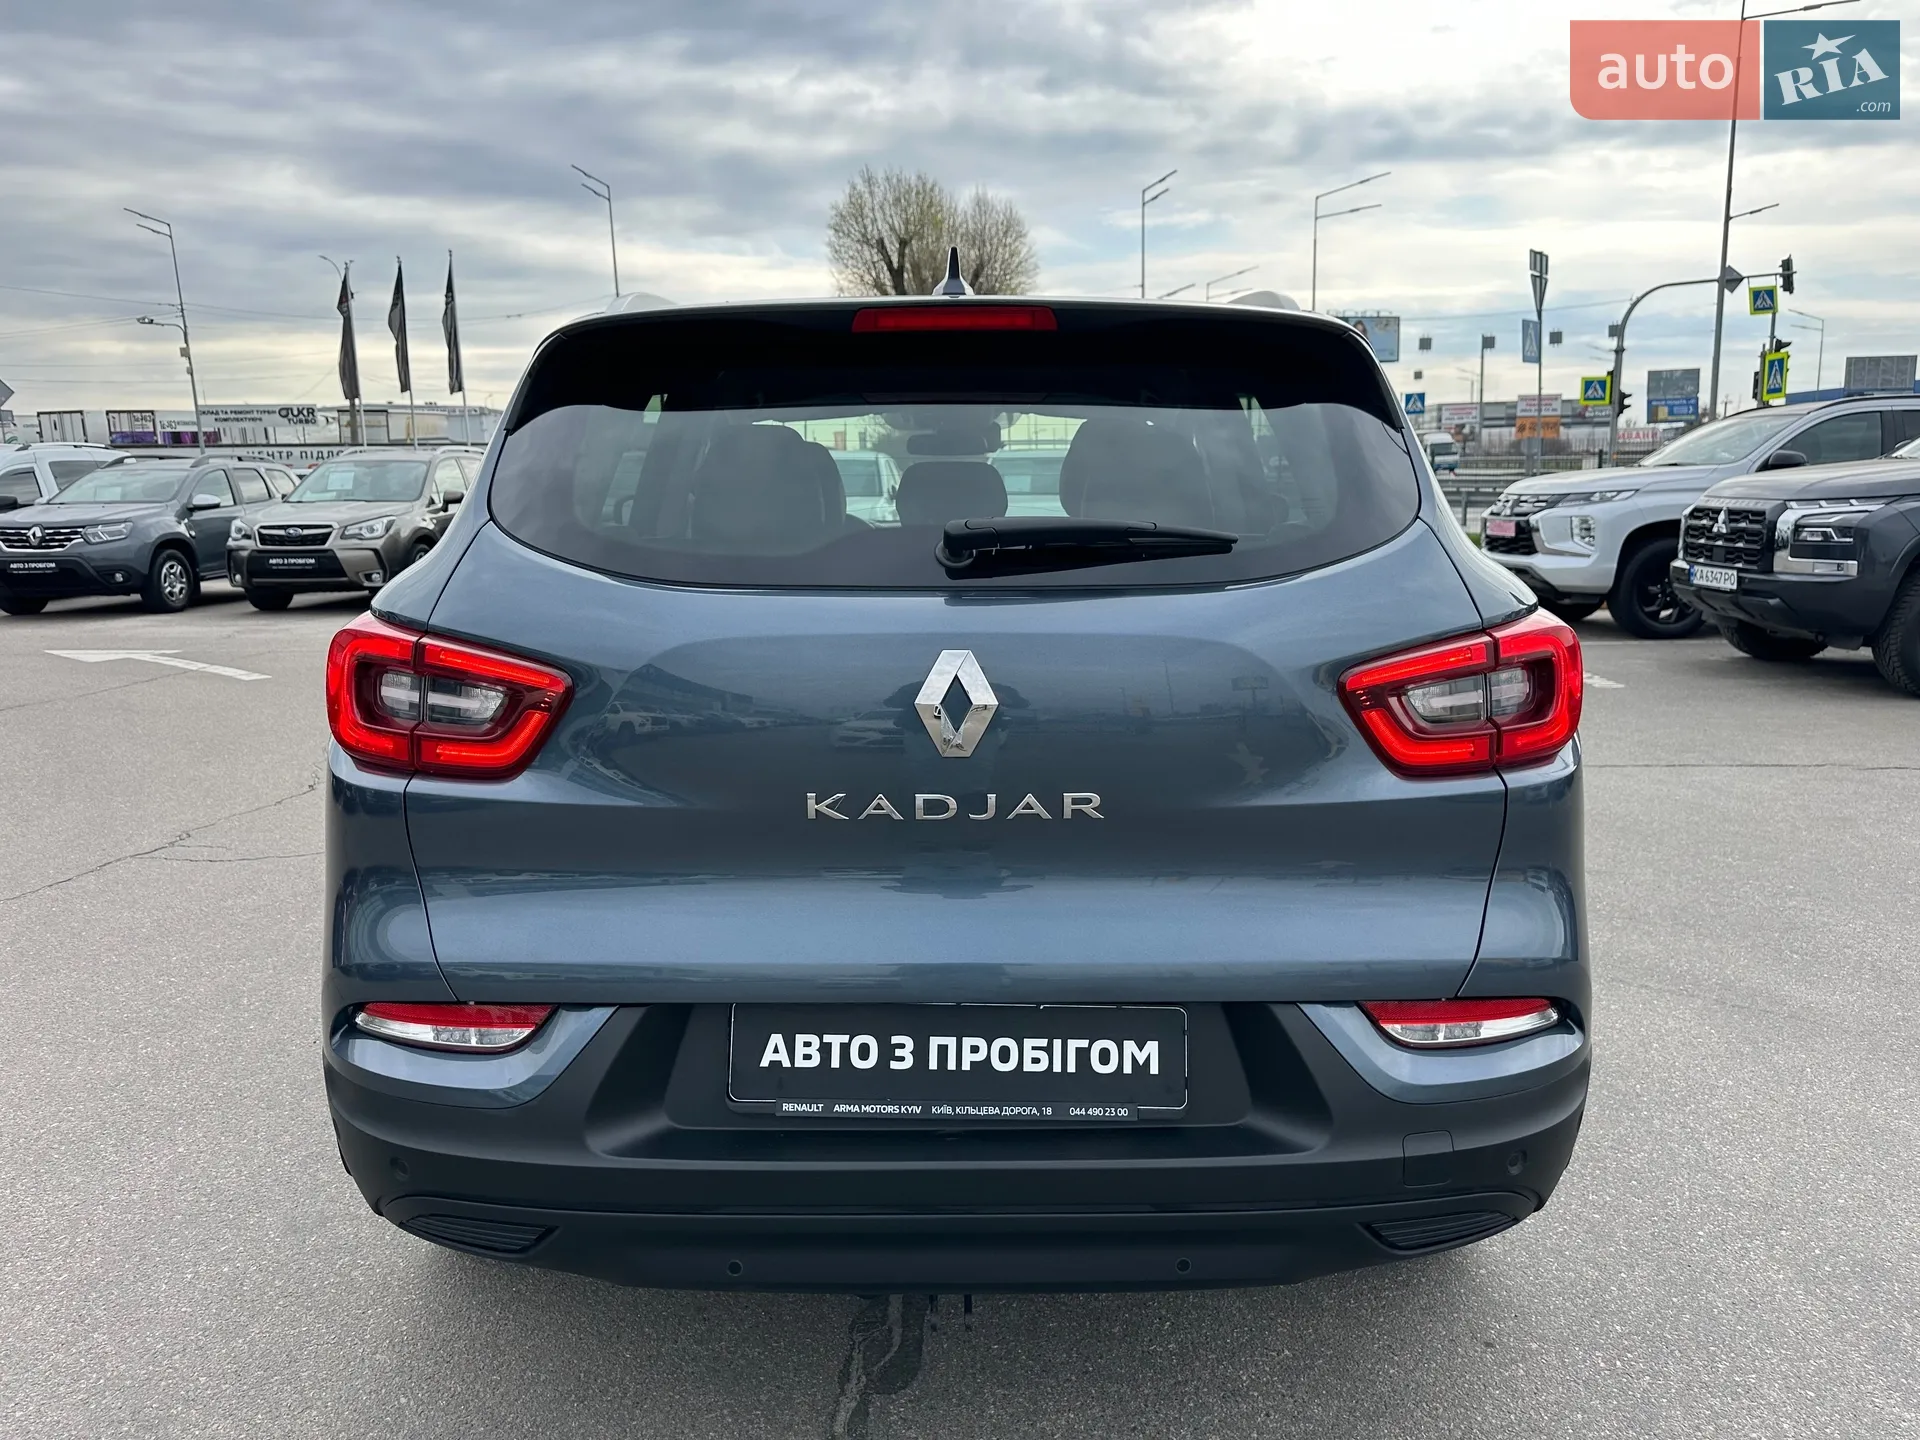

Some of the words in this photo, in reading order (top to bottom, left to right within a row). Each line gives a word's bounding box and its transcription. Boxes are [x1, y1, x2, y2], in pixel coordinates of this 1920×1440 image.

[287, 417, 317, 425] TURBO
[806, 792, 1105, 820] KADJAR
[759, 1032, 880, 1070] АВТО
[889, 1035, 915, 1071] З
[928, 1036, 1160, 1075] ПРОБІГОМ
[782, 1102, 824, 1112] RENAULT
[833, 1103, 861, 1113] ARMA
[861, 1104, 900, 1114] MOTORS
[900, 1105, 922, 1114] KYIV
[931, 1104, 955, 1116] КИЇВ,
[955, 1105, 1000, 1116] КІЛЬЦЕВА
[1001, 1106, 1040, 1117] ДОРОГА,
[1041, 1107, 1053, 1116] 18
[1069, 1107, 1086, 1116] 044
[1086, 1107, 1103, 1117] 490
[1104, 1108, 1116, 1117] 23
[1116, 1108, 1129, 1117] 00
